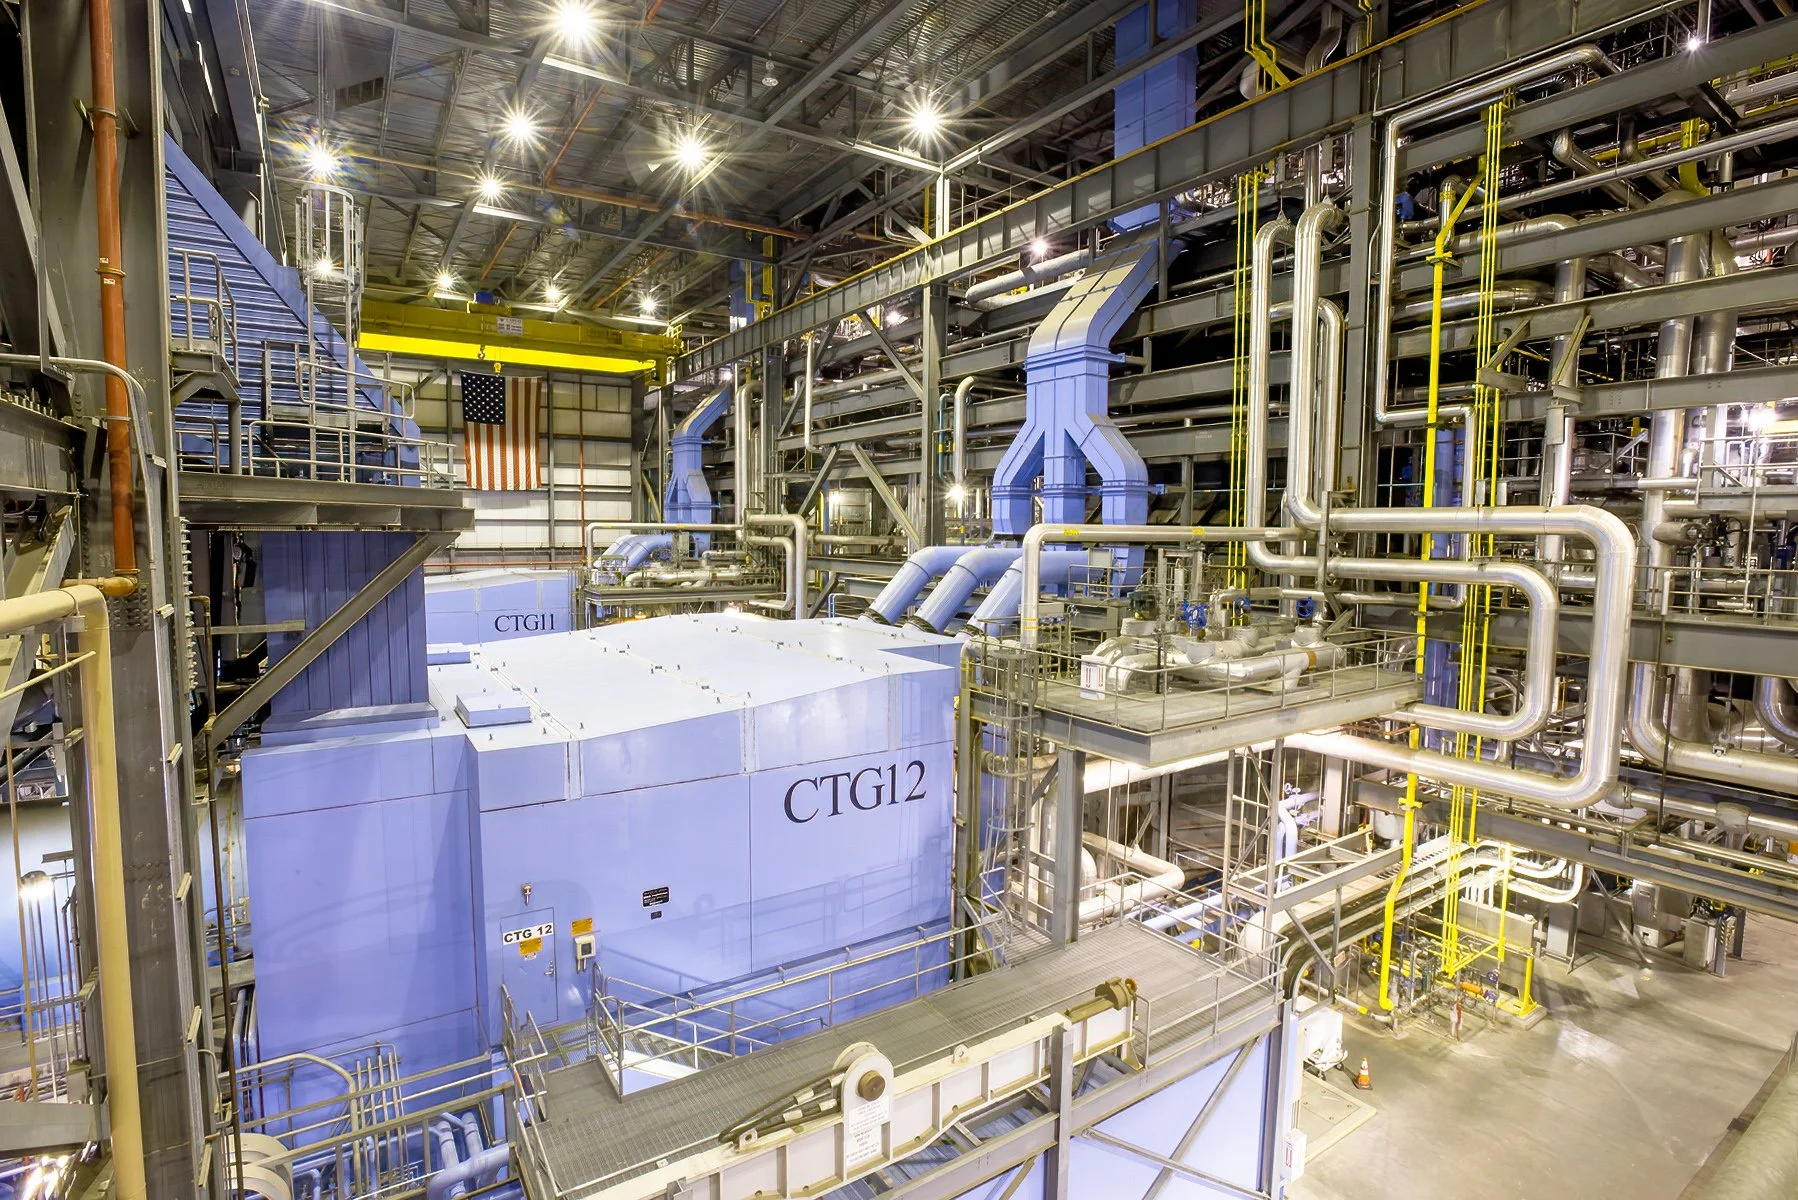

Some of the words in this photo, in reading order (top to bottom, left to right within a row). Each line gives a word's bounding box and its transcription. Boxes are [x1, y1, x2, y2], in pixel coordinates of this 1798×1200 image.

[494, 613, 555, 633] CTG11
[783, 759, 927, 824] CTG12
[503, 928, 532, 943] CTG
[537, 924, 553, 935] 12
